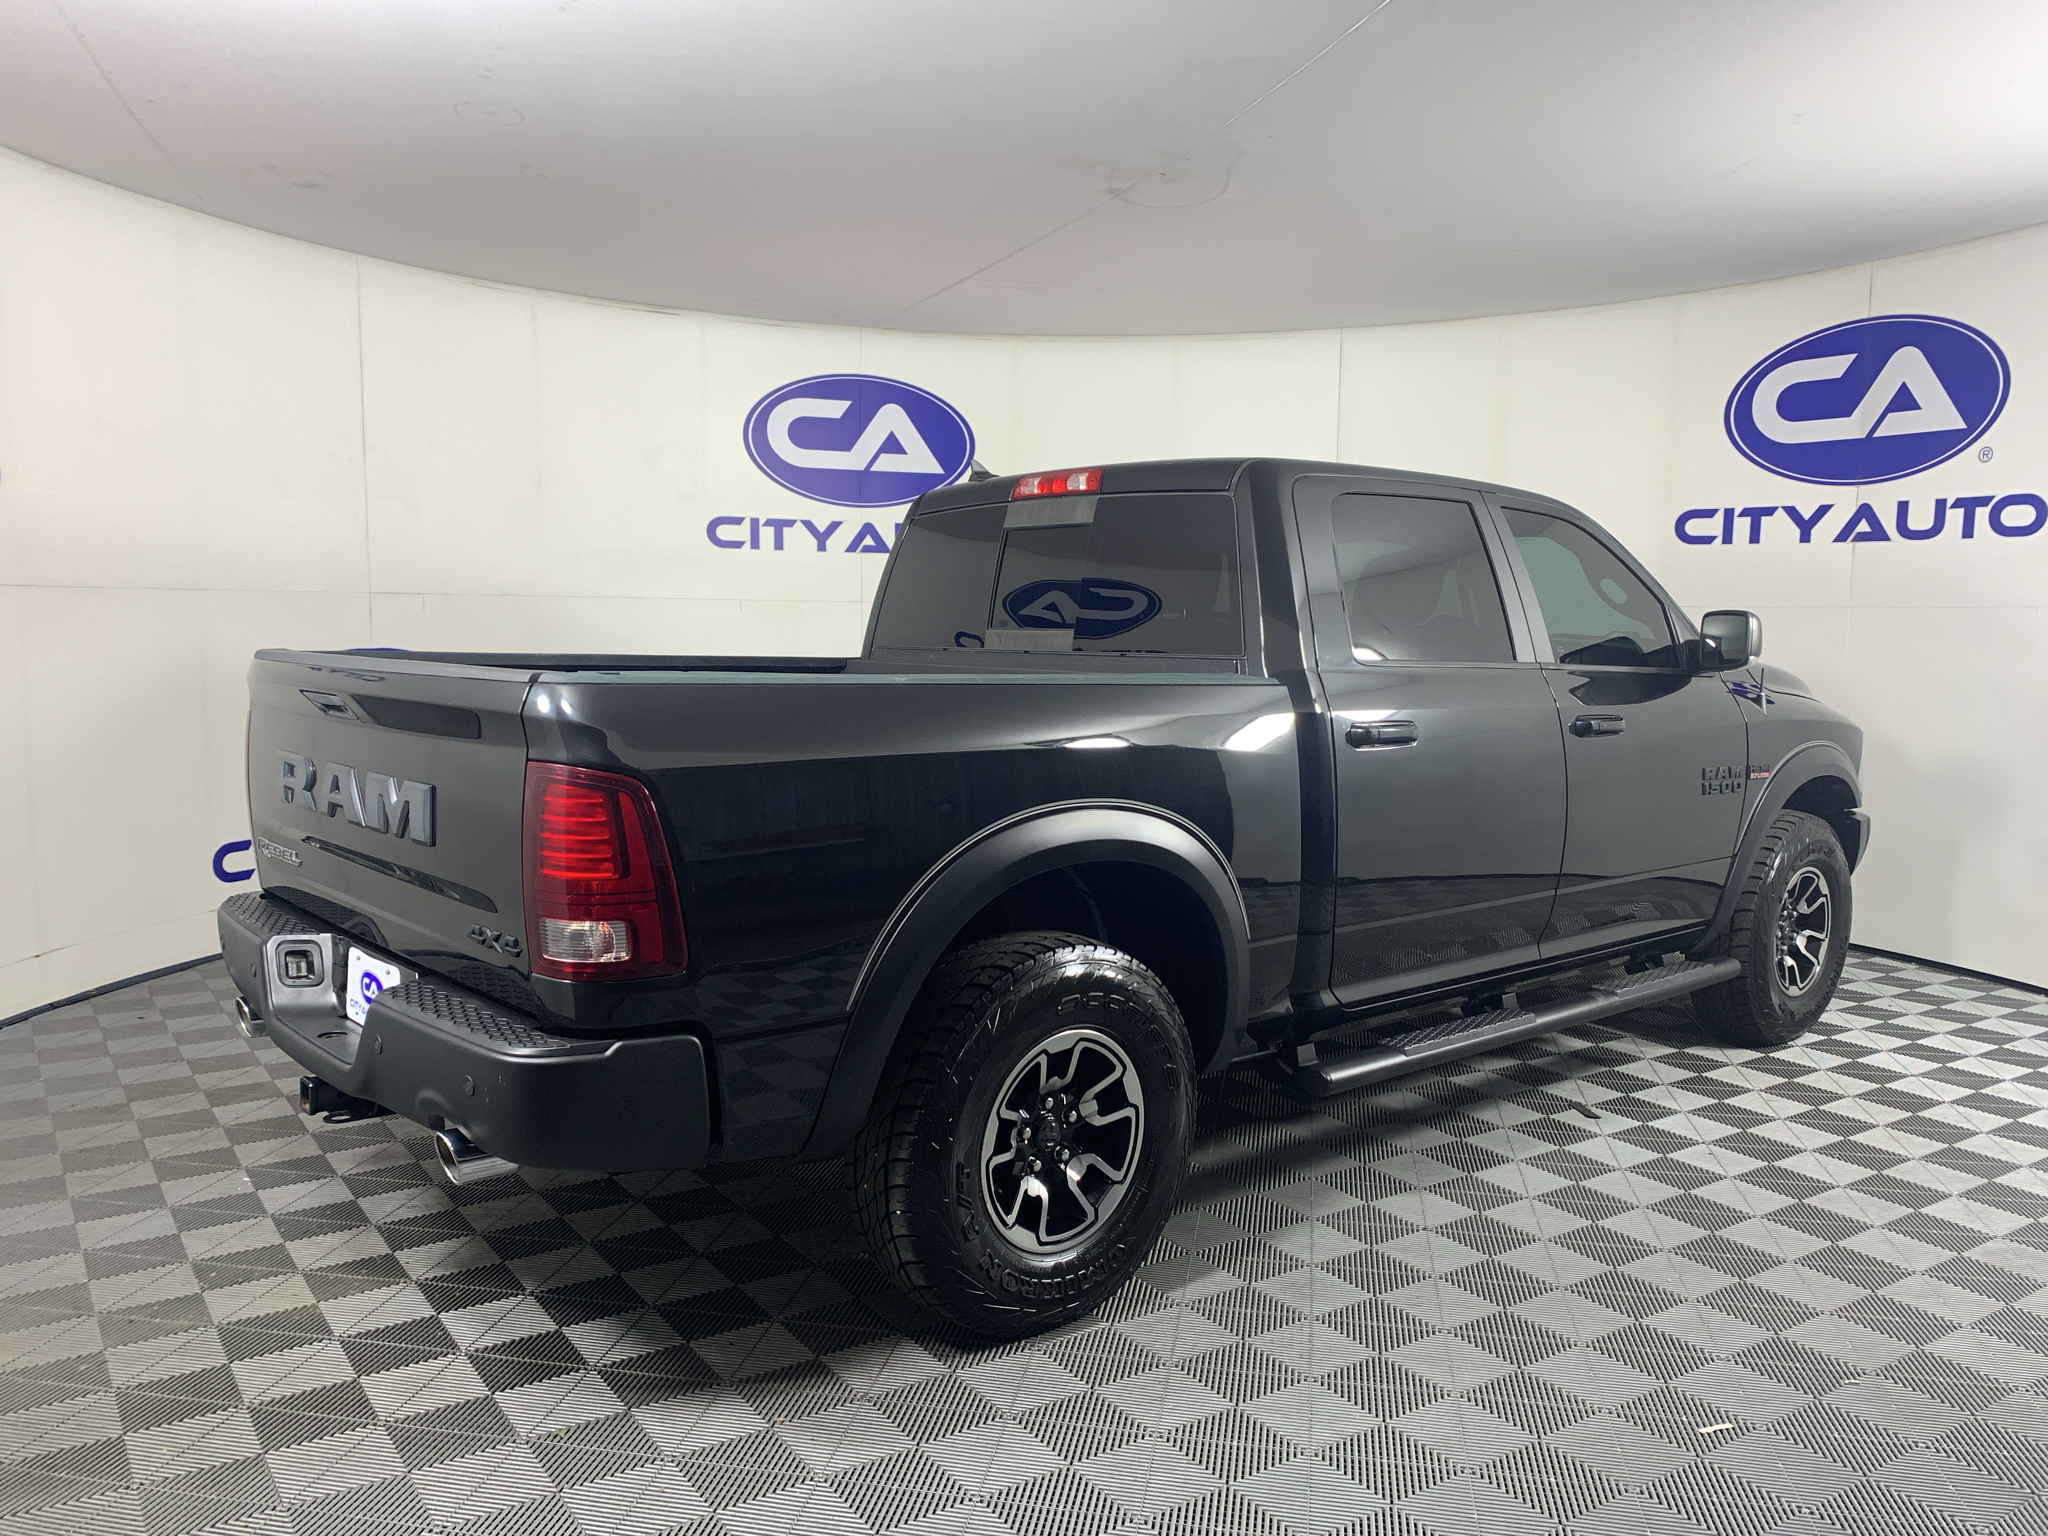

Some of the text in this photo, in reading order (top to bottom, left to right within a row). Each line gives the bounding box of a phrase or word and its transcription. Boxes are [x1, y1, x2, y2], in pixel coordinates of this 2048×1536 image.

[1751, 345, 1968, 444] CA
[766, 397, 945, 475] CA
[706, 516, 903, 553] CITY A
[1674, 493, 2048, 545] CITY AUTO
[1701, 765, 1745, 781] RAM
[1701, 780, 1743, 796] 1500
[277, 751, 436, 847] RAM
[257, 836, 303, 867] REBEL
